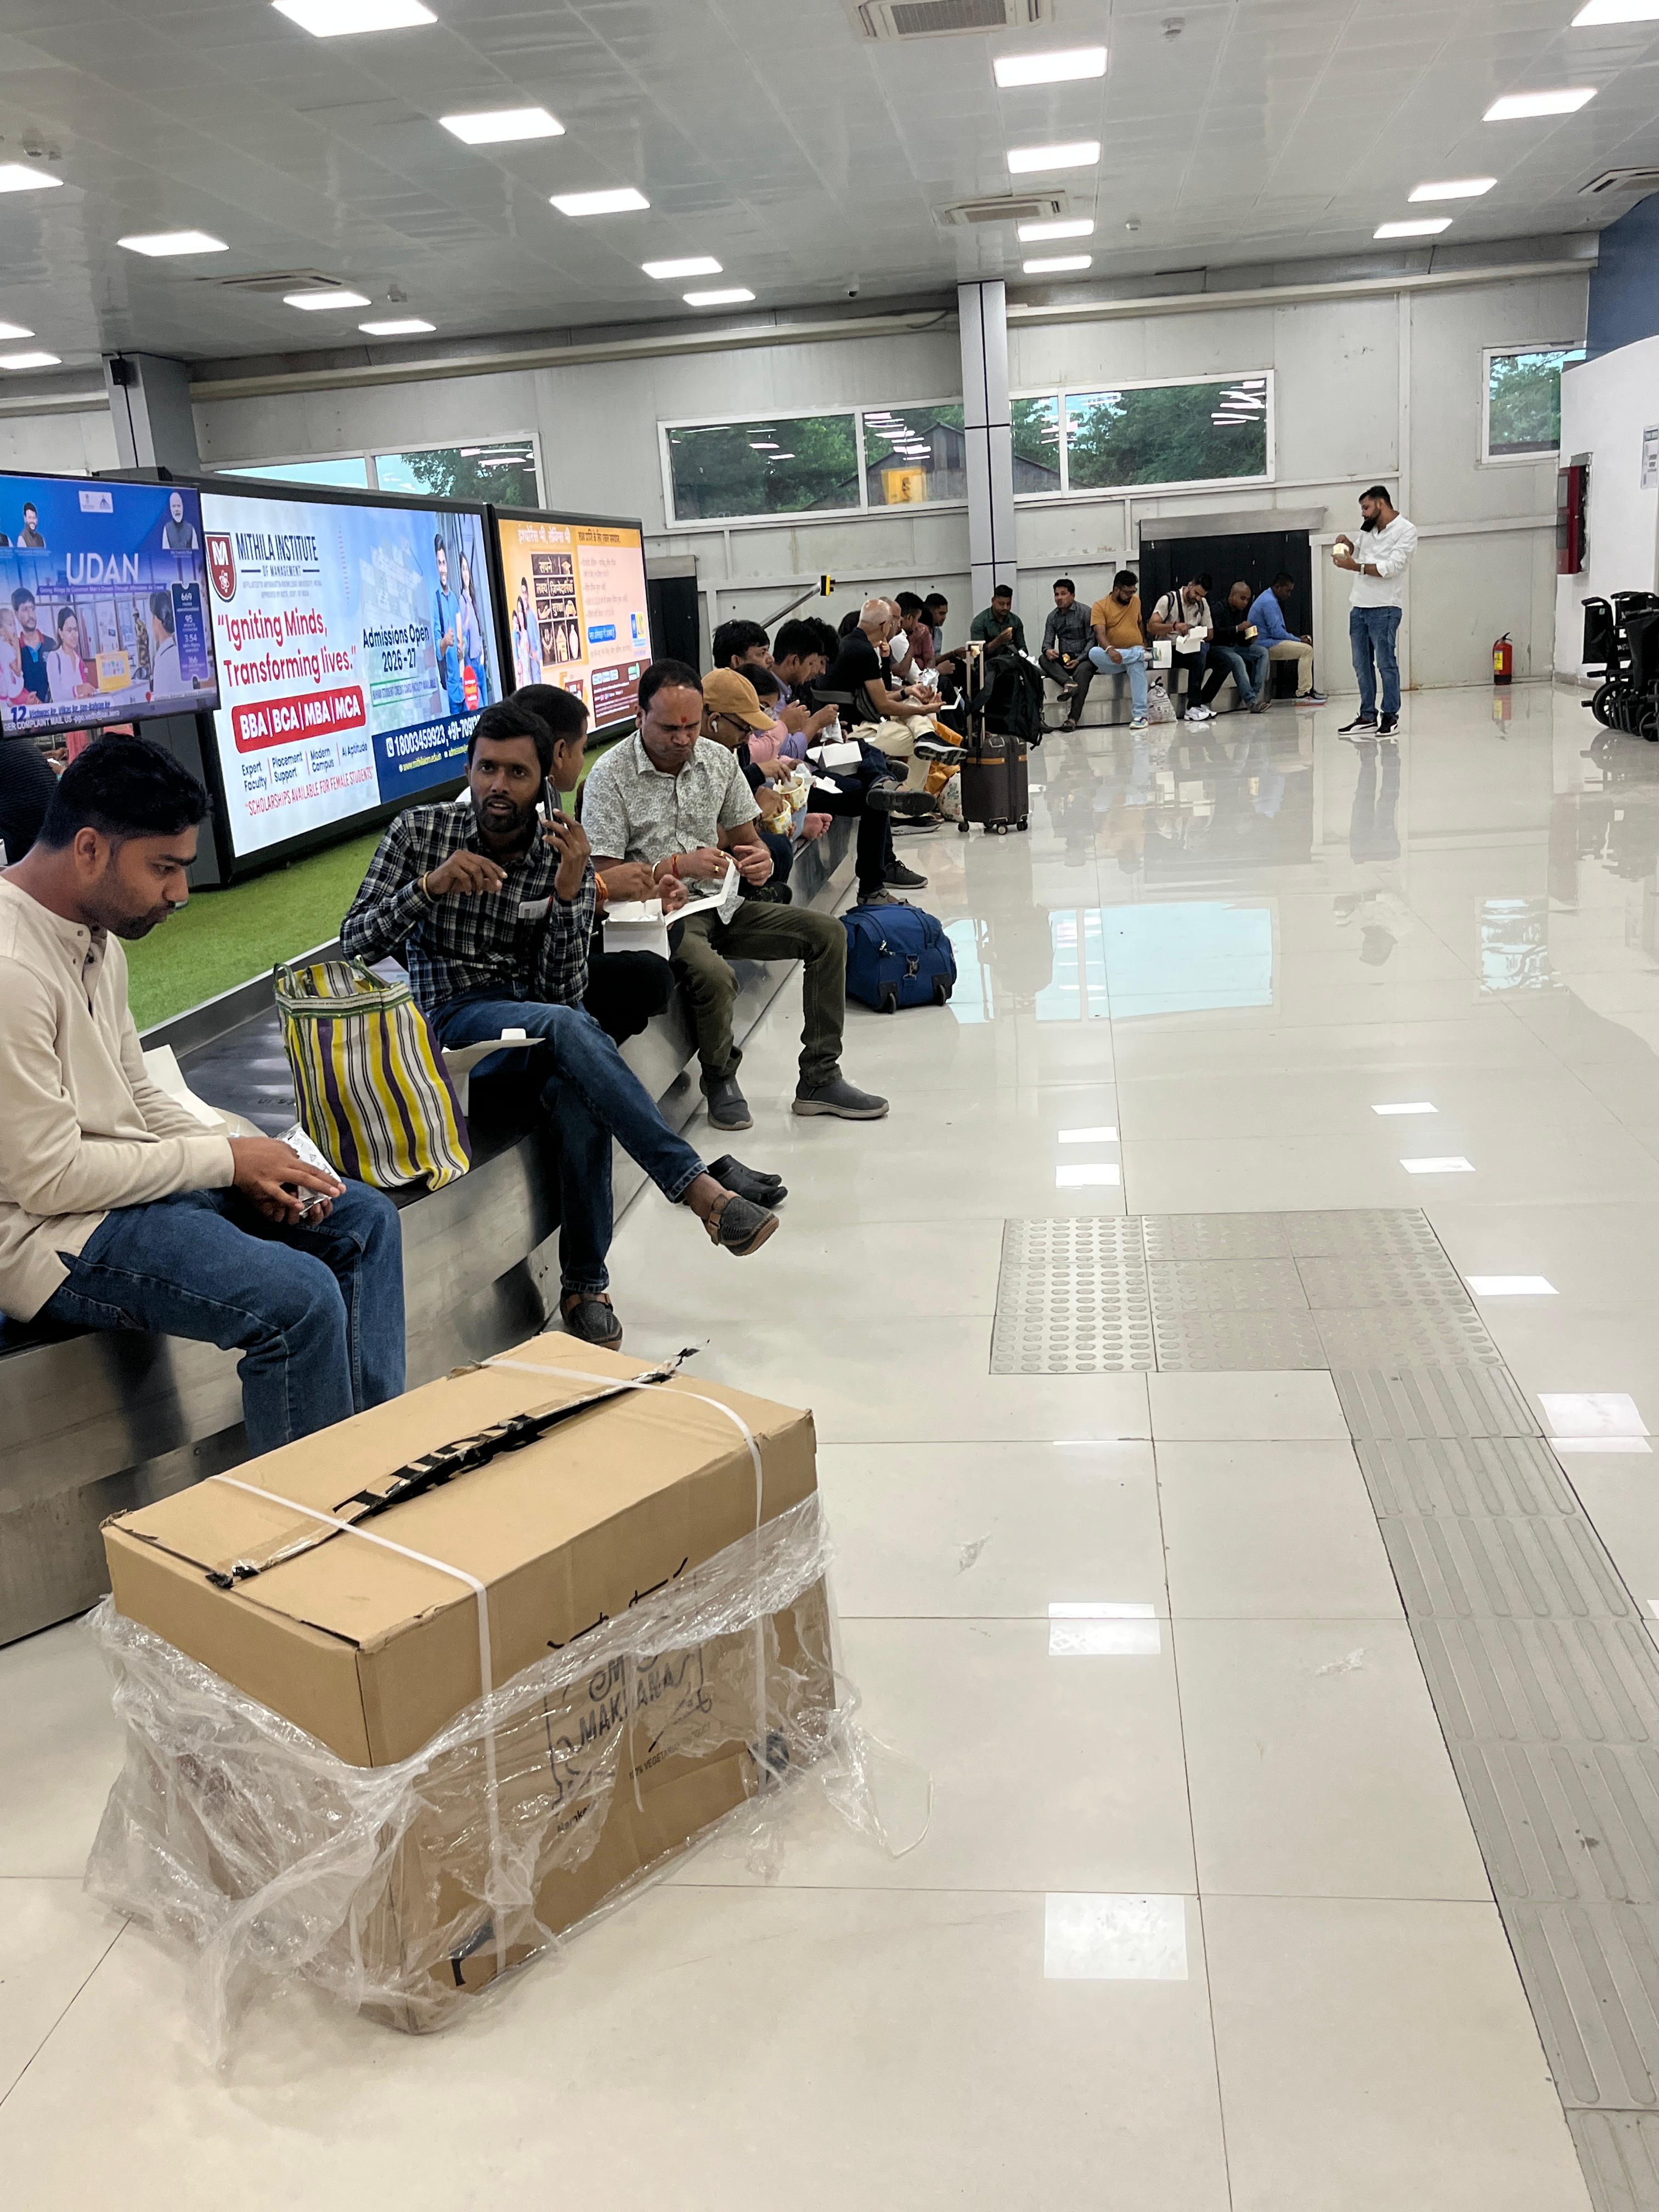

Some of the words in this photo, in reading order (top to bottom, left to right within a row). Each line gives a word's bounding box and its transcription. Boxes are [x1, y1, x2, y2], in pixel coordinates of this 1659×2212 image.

[235, 533, 275, 560] MITHILA
[275, 534, 318, 561] INSTITUTE
[66, 552, 139, 584] UDAN
[262, 566, 268, 577] OF
[270, 565, 301, 577] MANAGEMENT
[538, 557, 552, 573] सपने
[185, 615, 193, 623] 95
[284, 607, 327, 637] Minds,
[184, 634, 198, 642] 3.54
[363, 624, 408, 648] Admissions
[409, 624, 430, 646] Open
[223, 648, 320, 687] Transforming
[10, 706, 27, 723] 12
[239, 712, 268, 740] BBA
[272, 706, 300, 733] BCA
[304, 700, 331, 726] MBA
[335, 695, 361, 720] MCA
[17, 718, 50, 730] COMPLAINT
[310, 748, 330, 761] Modern
[342, 746, 347, 757] AI
[347, 742, 368, 758] Aptitude
[272, 751, 303, 768] Placement
[312, 759, 334, 772] Campus
[242, 761, 262, 778] Expert
[274, 767, 297, 785] Support
[244, 776, 267, 792] Faculty
[292, 782, 320, 803] AVAILABLE
[320, 779, 330, 794] FOR
[330, 773, 349, 790] FEMALE
